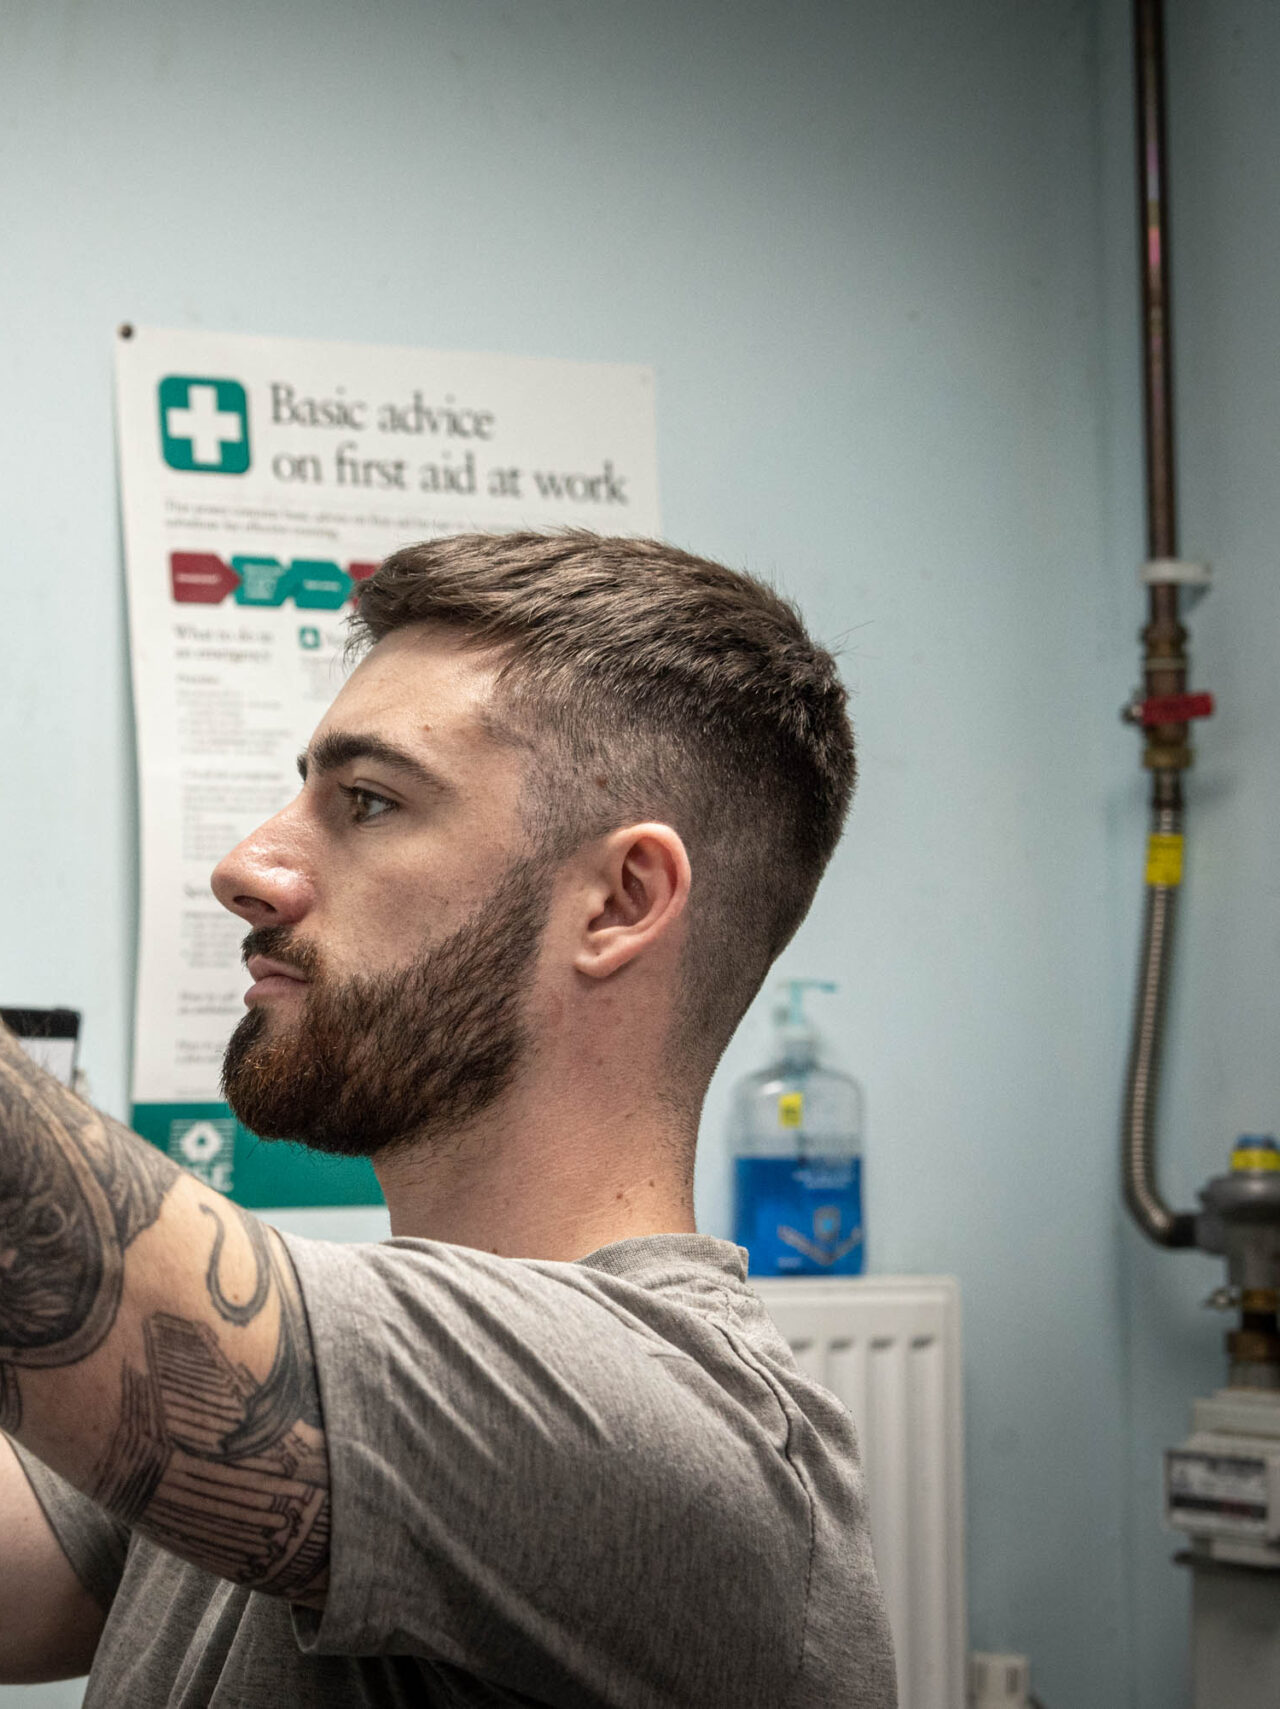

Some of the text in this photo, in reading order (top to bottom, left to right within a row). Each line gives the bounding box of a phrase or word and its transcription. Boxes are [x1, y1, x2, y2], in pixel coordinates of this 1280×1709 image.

[271, 381, 495, 440] Basic advice
[272, 440, 628, 505] on first aid at work
